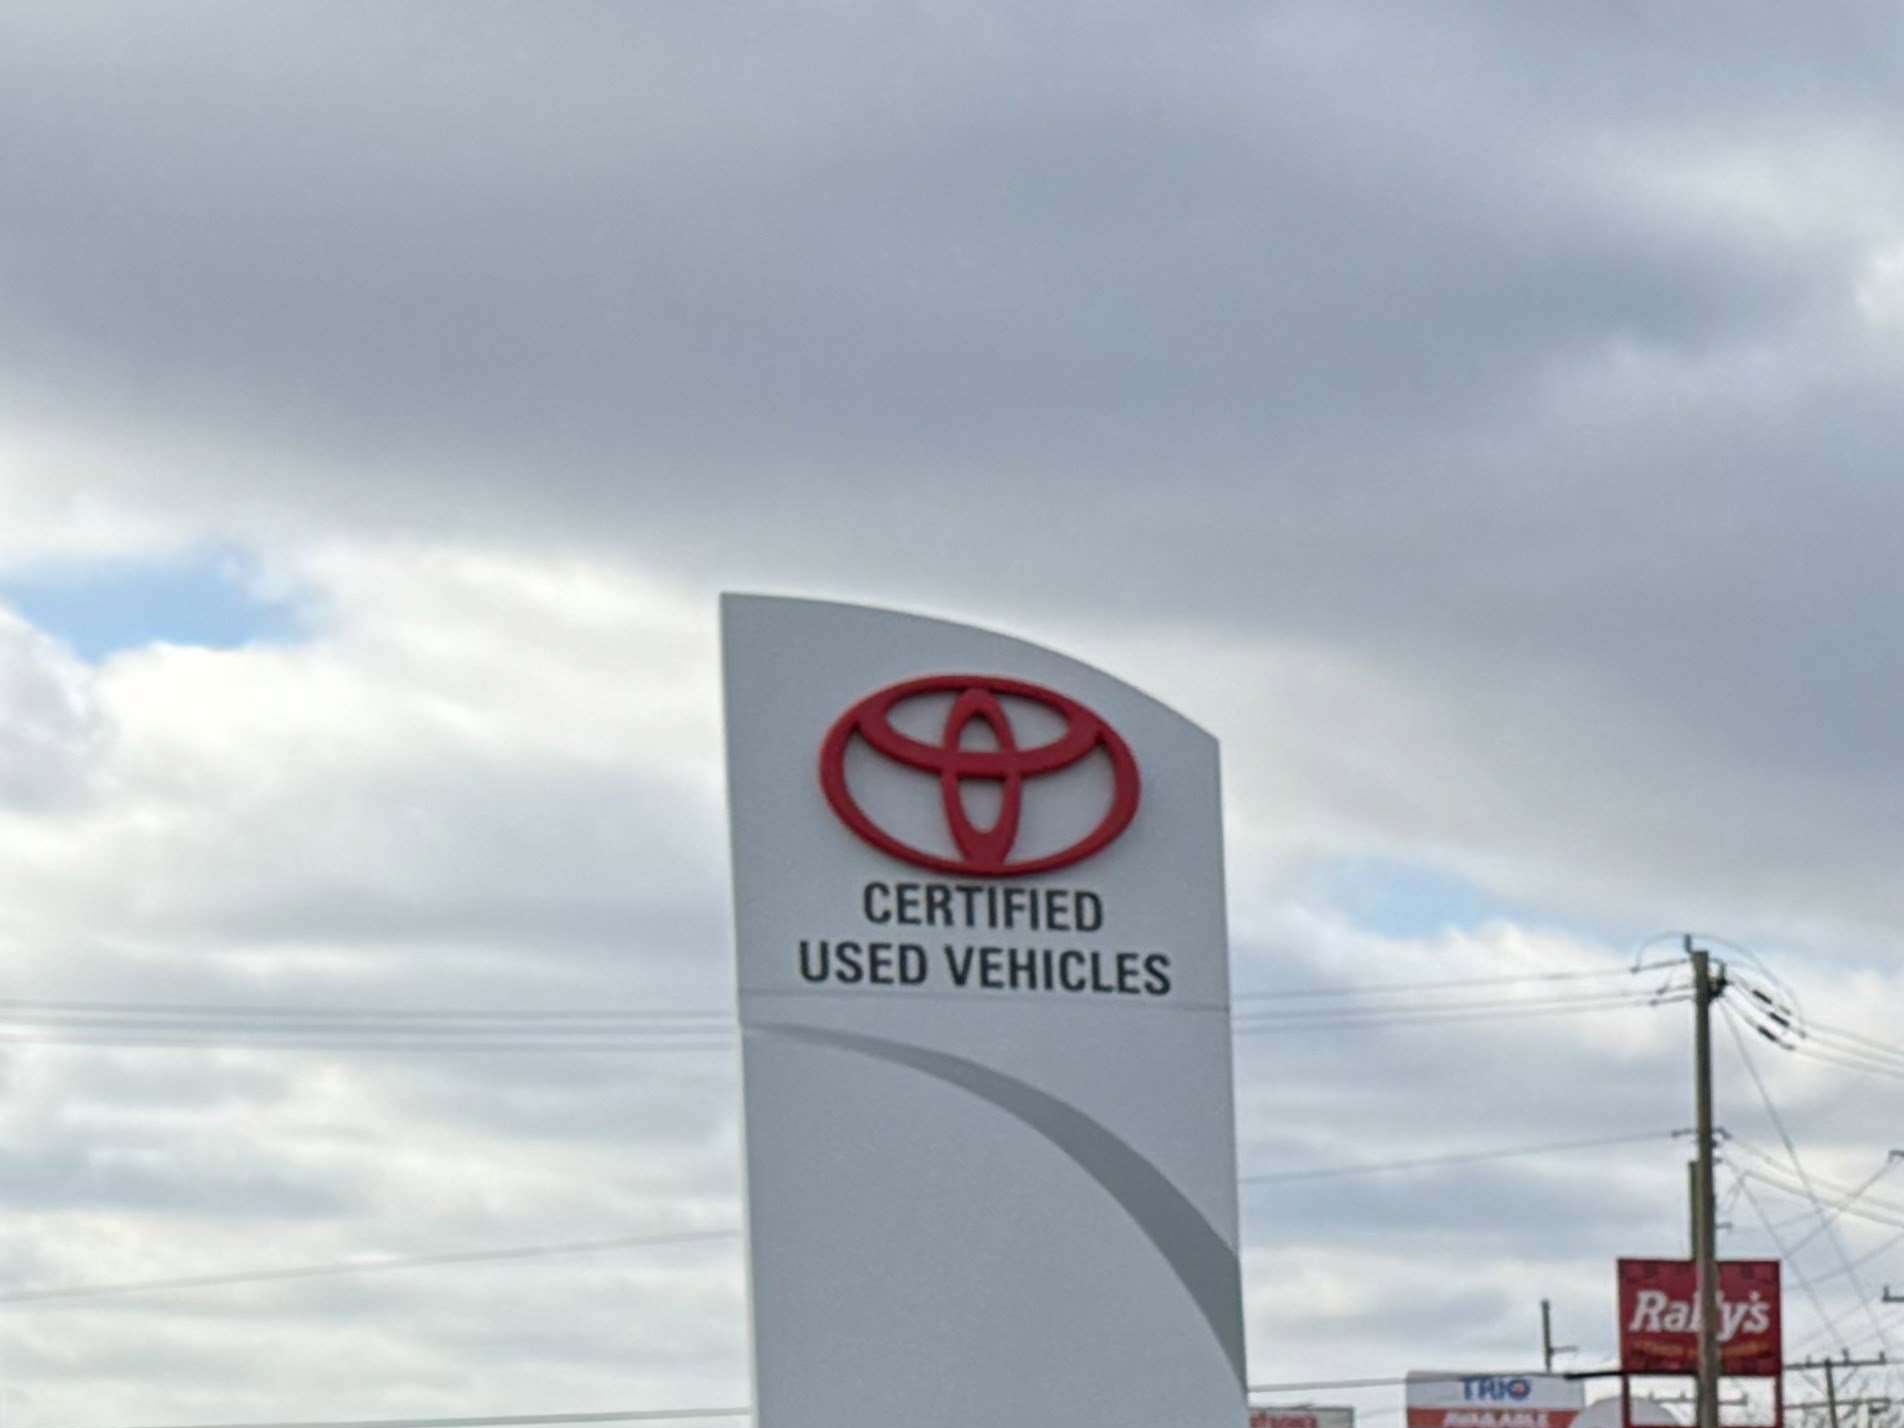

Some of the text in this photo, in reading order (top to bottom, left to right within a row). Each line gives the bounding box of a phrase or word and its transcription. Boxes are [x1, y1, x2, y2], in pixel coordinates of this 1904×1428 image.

[862, 881, 1104, 933] CERTIFIED
[799, 940, 1173, 996] USED VEHICLES
[1629, 1288, 1771, 1342] Raly's
